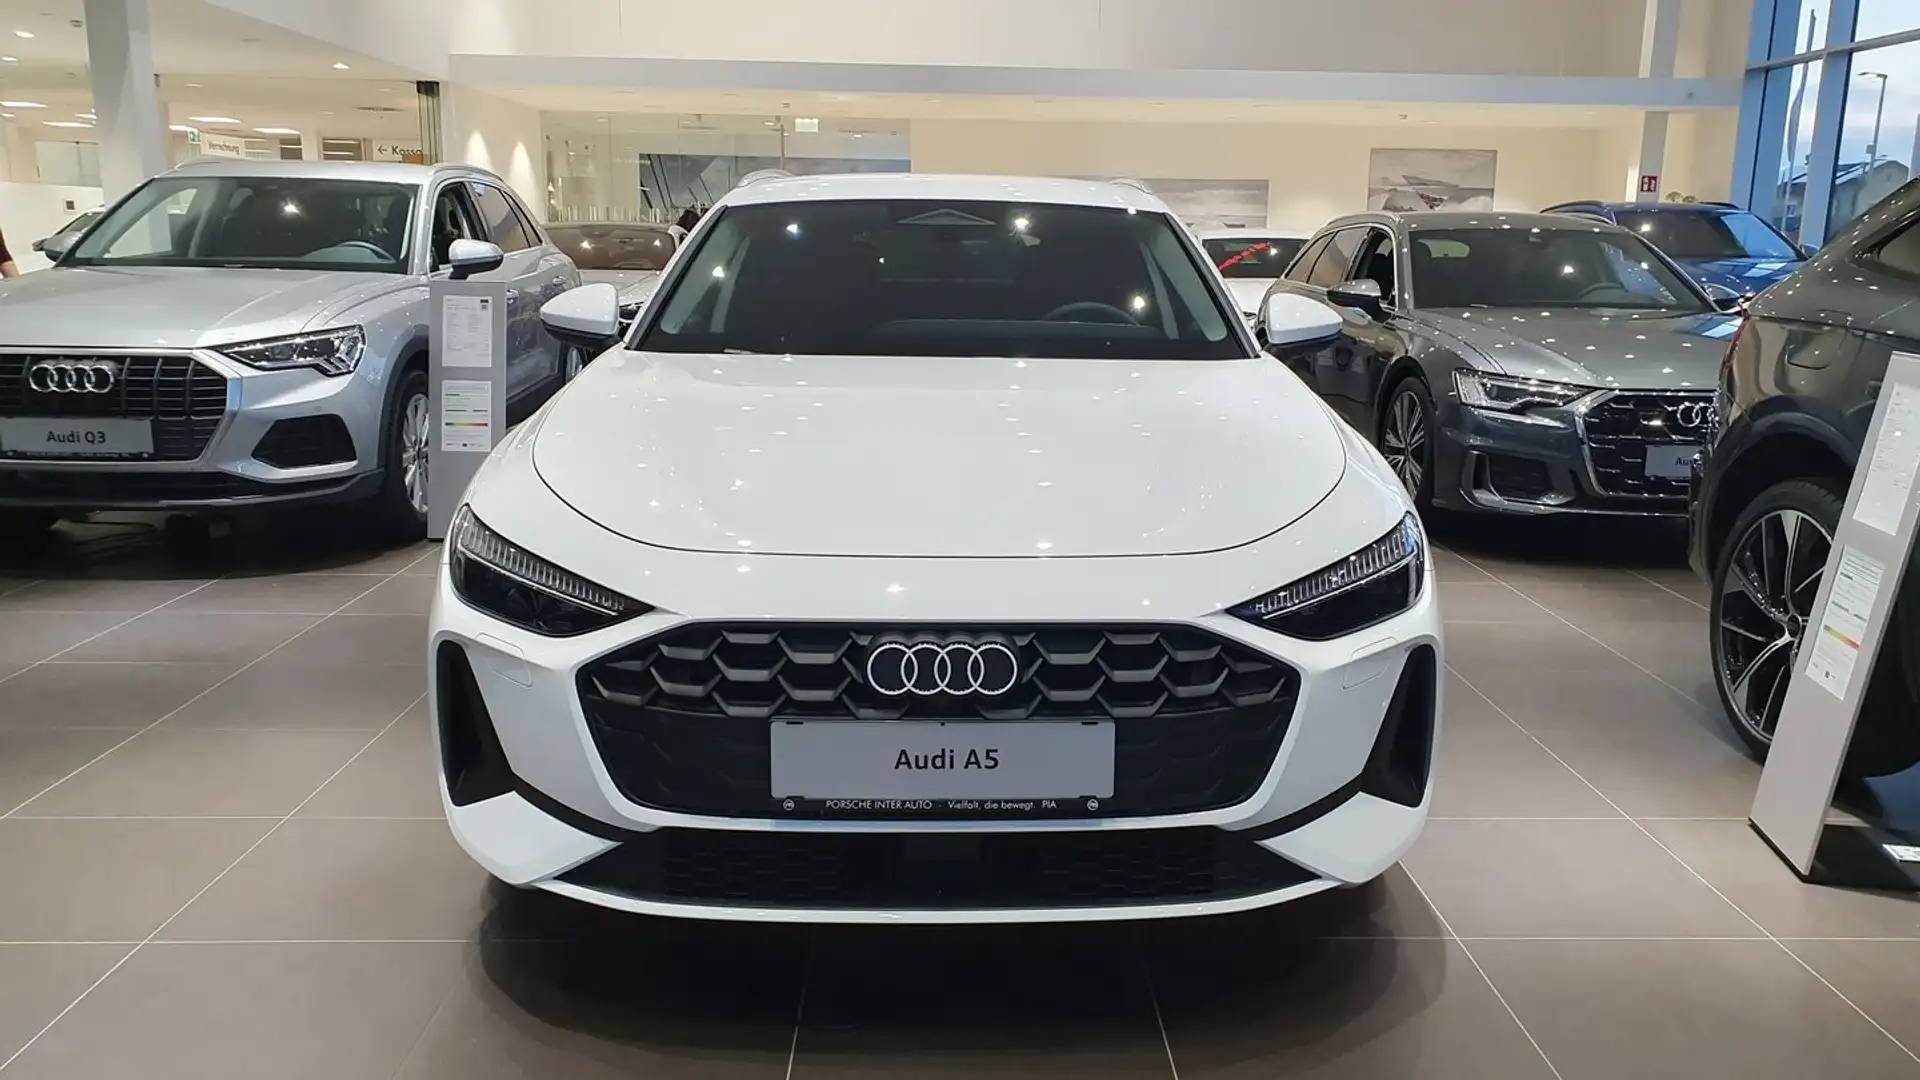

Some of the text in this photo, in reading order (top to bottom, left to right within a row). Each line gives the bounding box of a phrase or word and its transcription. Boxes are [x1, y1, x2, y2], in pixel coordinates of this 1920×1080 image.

[46, 430, 107, 445] Audi Q3
[894, 747, 999, 770] Audi A5
[826, 799, 871, 809] PORSCHE
[874, 799, 902, 809] INTER
[904, 799, 933, 810] AUTO
[947, 799, 981, 811] Vielfalt,
[984, 799, 999, 810] die
[1041, 799, 1058, 809] PIA
